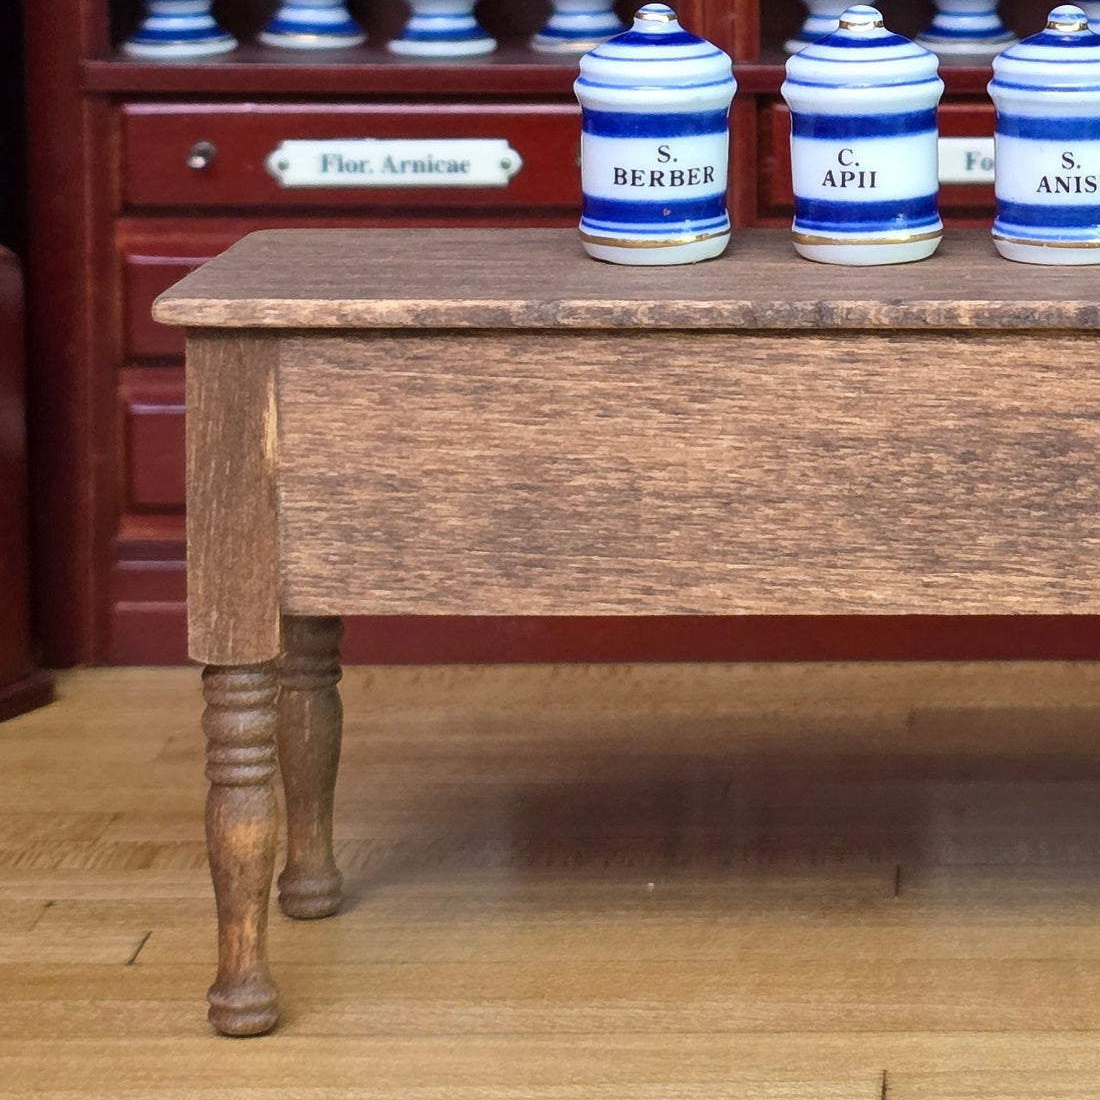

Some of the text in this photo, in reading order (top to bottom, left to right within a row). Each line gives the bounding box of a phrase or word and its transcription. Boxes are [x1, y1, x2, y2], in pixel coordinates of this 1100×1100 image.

[320, 153, 471, 175] Flor. Arnicae
[657, 144, 678, 164] S.
[837, 148, 860, 168] C.
[1061, 151, 1081, 171] S.
[613, 165, 716, 188] BERBER
[821, 170, 877, 189] APII
